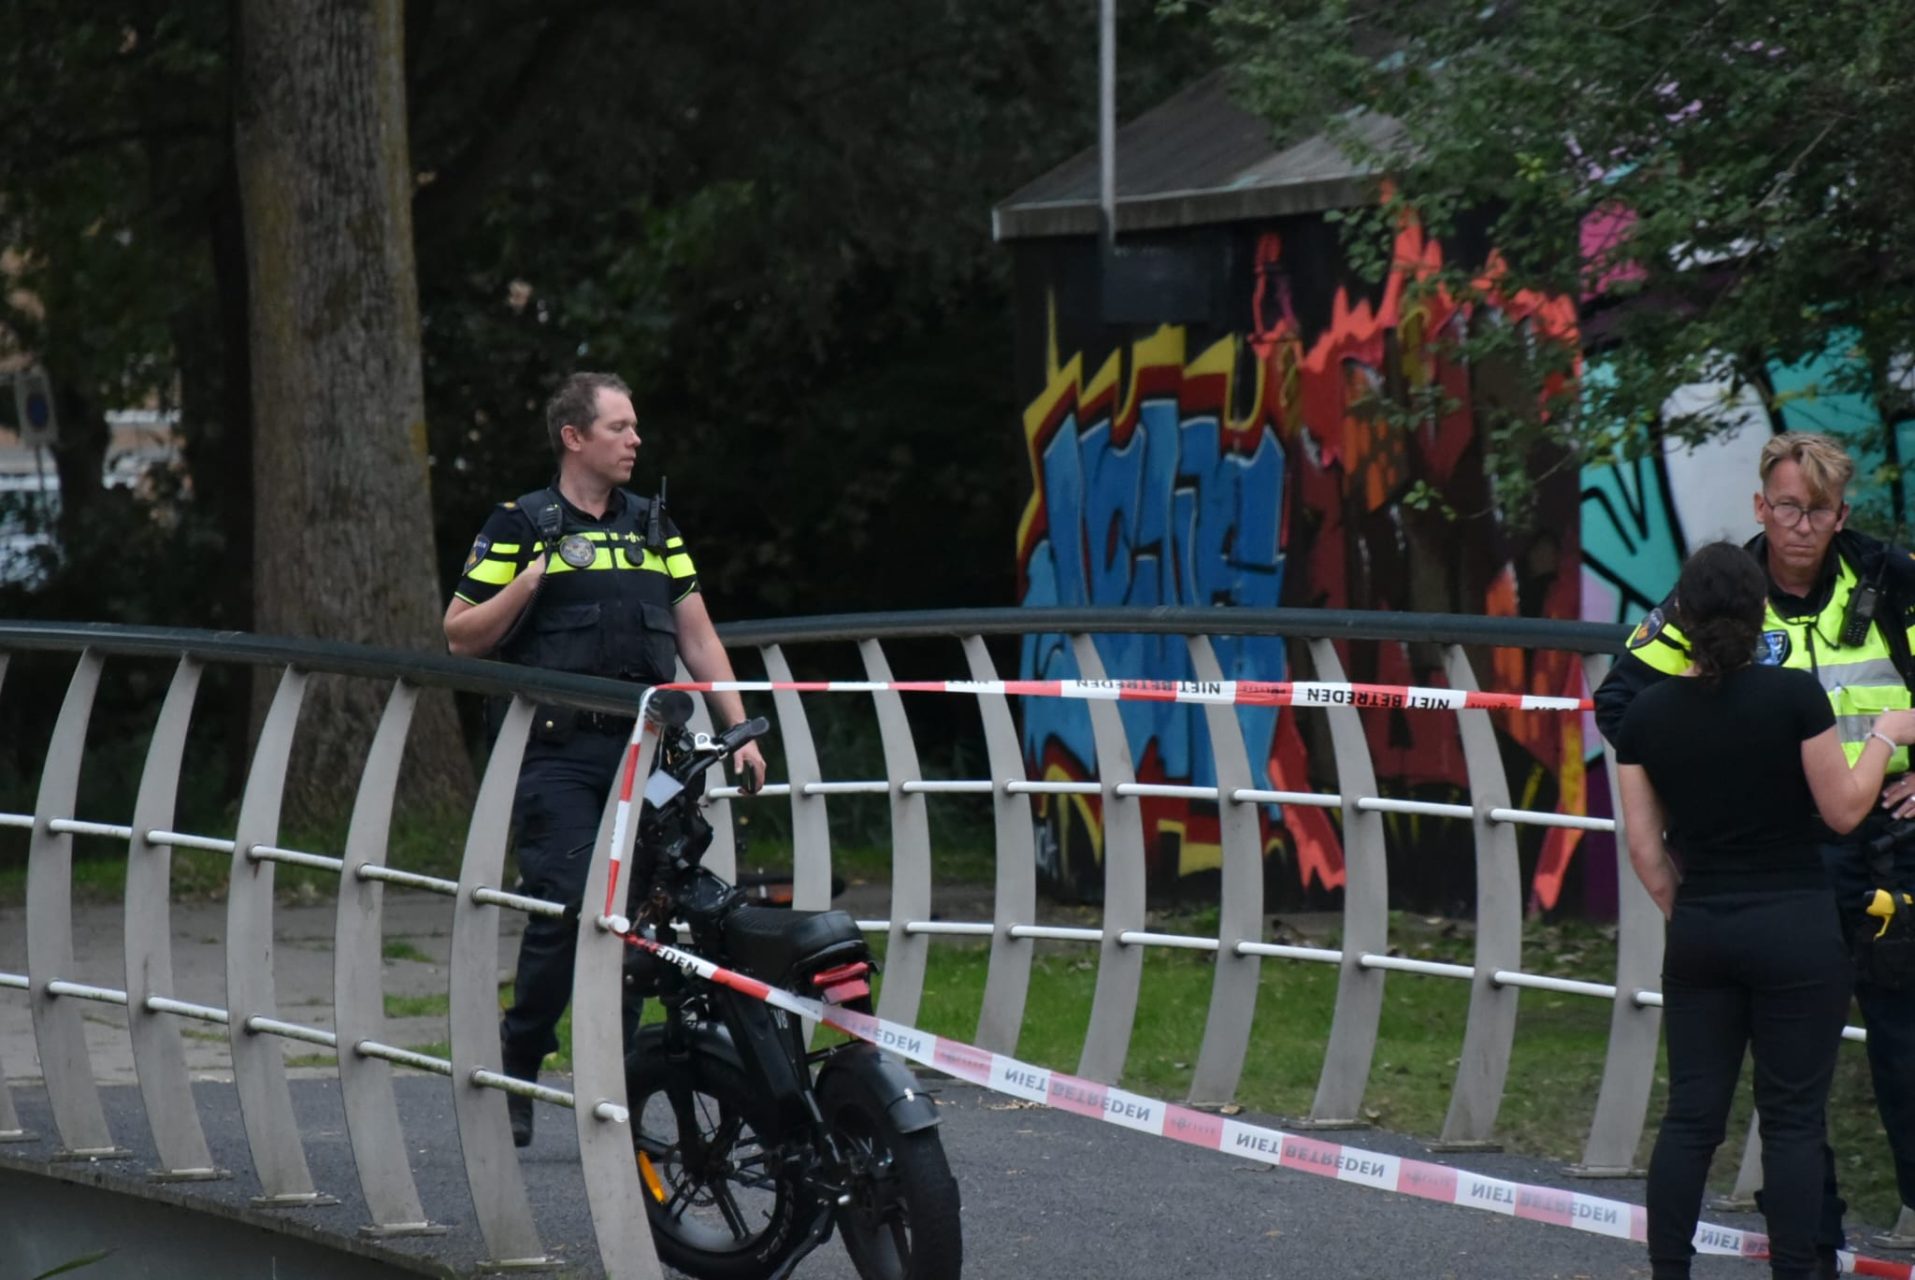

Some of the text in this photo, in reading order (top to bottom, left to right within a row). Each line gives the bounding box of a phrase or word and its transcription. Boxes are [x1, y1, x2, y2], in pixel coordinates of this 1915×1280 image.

[1179, 681, 1221, 695] NIET
[1307, 688, 1450, 709] NIET BETREDEN
